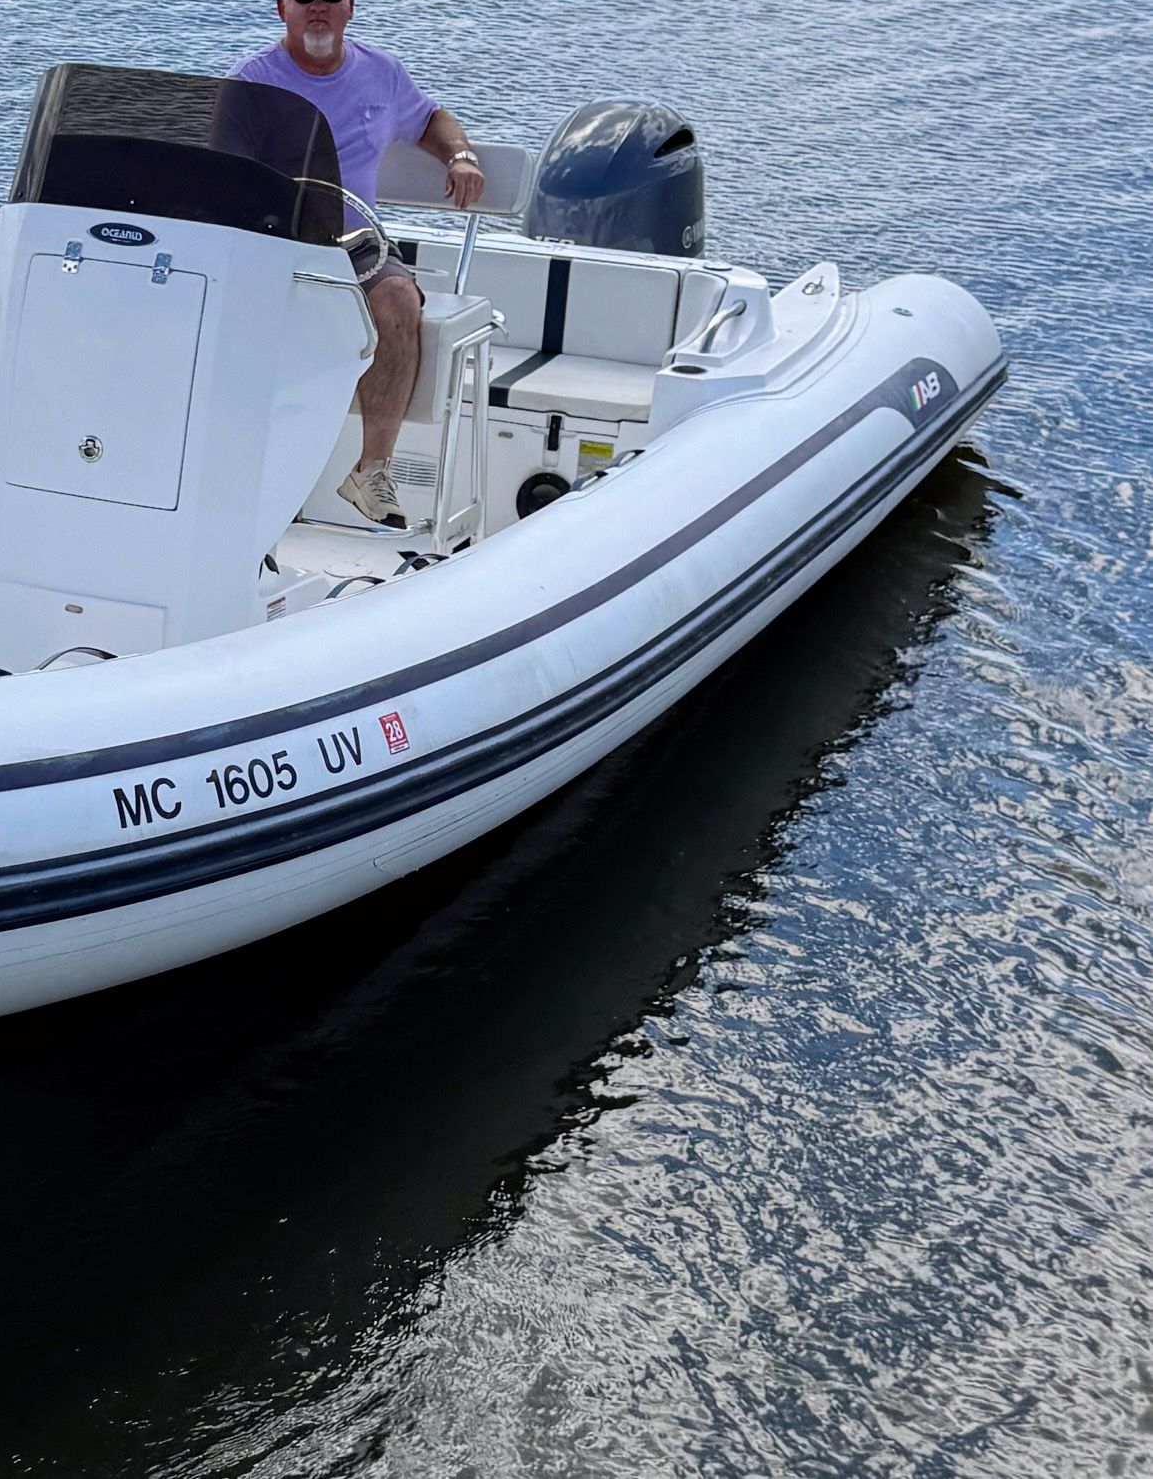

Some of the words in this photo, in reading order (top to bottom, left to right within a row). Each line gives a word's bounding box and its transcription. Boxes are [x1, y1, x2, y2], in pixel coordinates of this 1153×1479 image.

[917, 371, 941, 405] AB
[385, 720, 404, 742] 28
[112, 777, 182, 829] MC
[205, 750, 297, 808] 1605
[317, 726, 362, 774] UV
